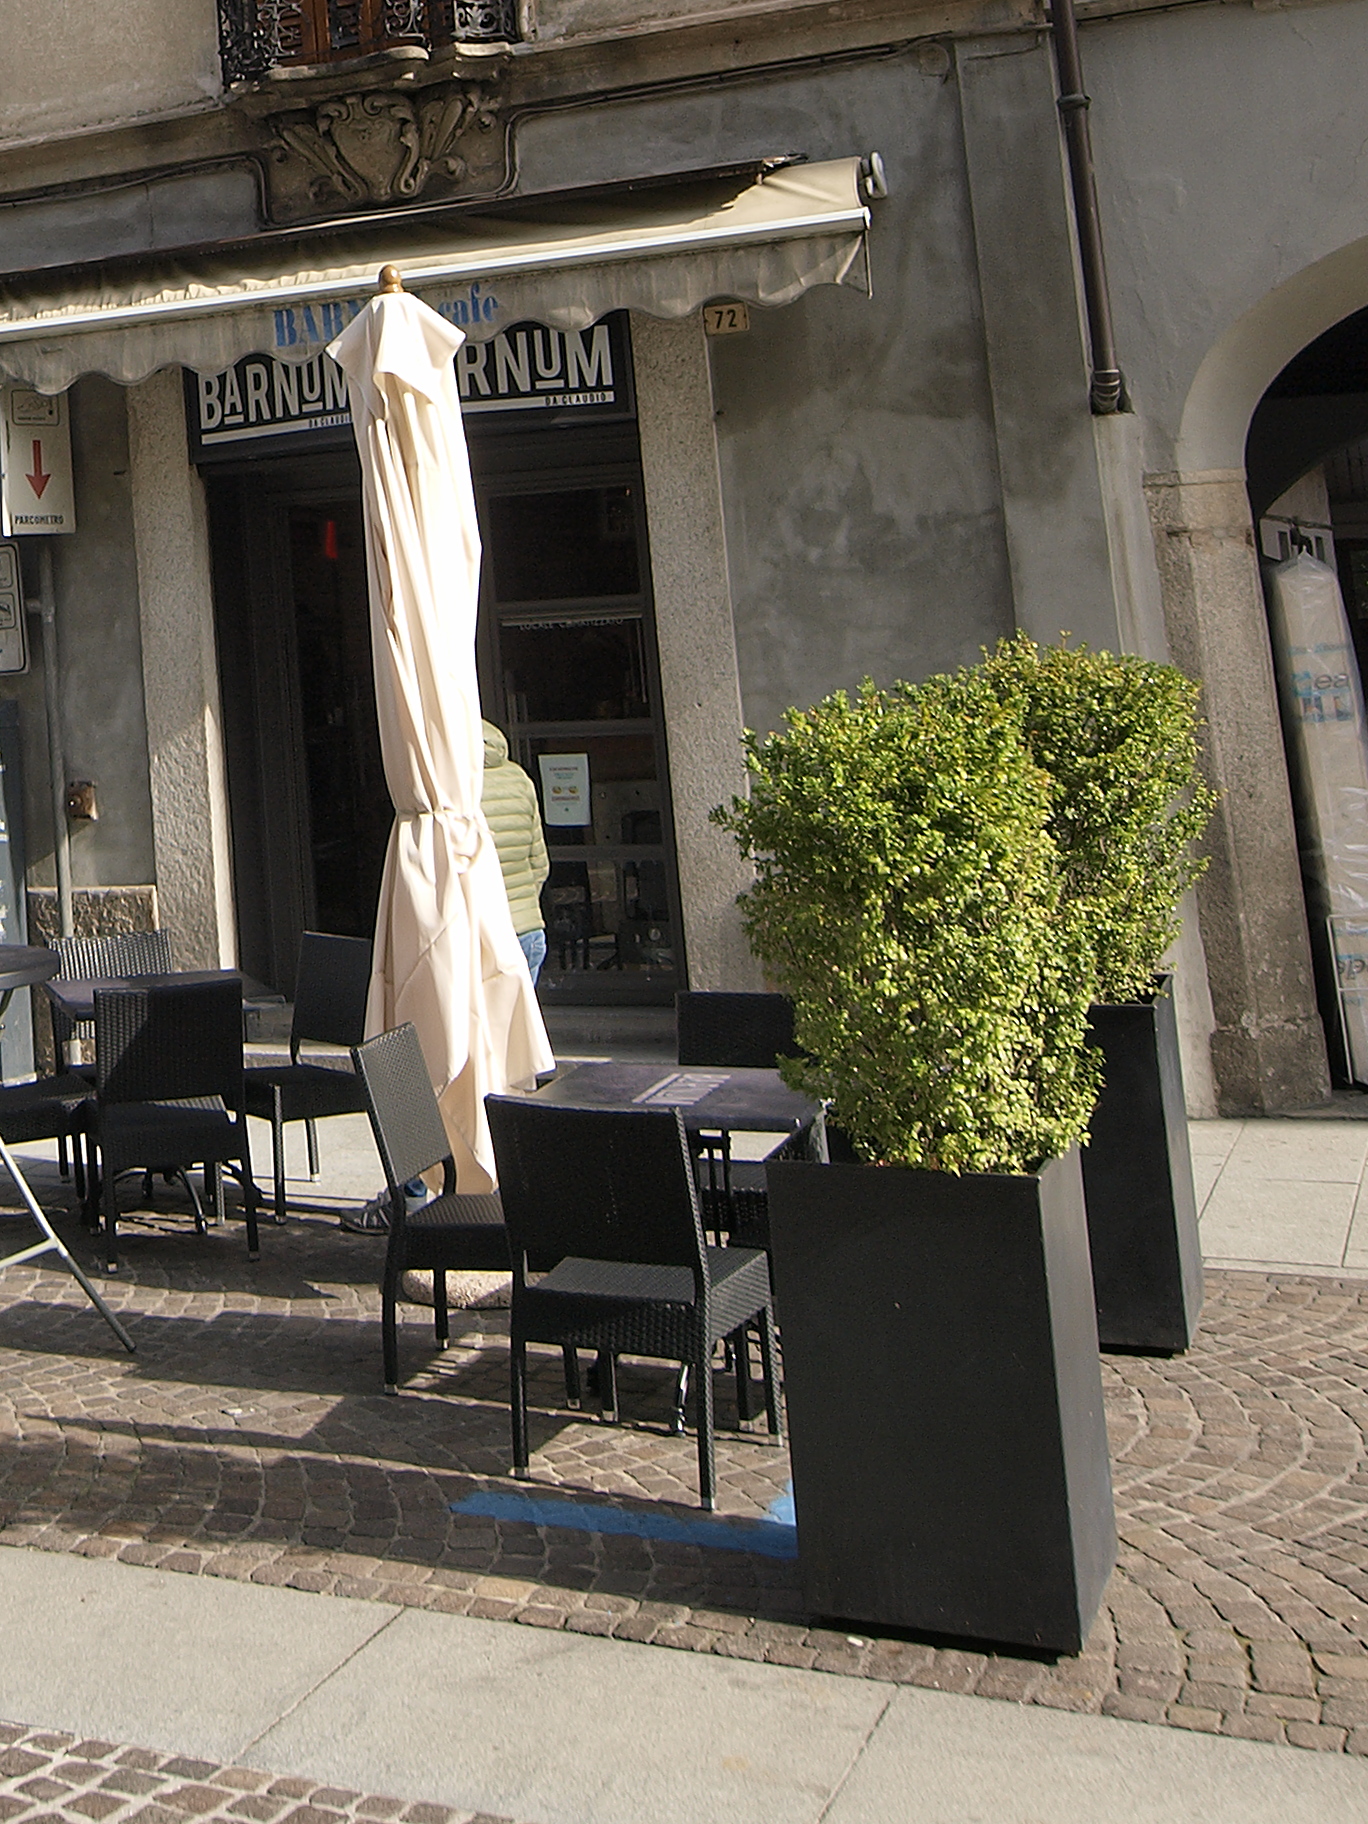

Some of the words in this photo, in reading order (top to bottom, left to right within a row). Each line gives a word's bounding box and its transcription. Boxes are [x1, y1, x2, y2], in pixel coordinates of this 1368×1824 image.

[714, 309, 737, 328] 72
[457, 325, 614, 398] RNUM
[545, 395, 558, 406] DA
[561, 392, 607, 405] CLAUDIO
[14, 514, 64, 525] PARCOMETRO
